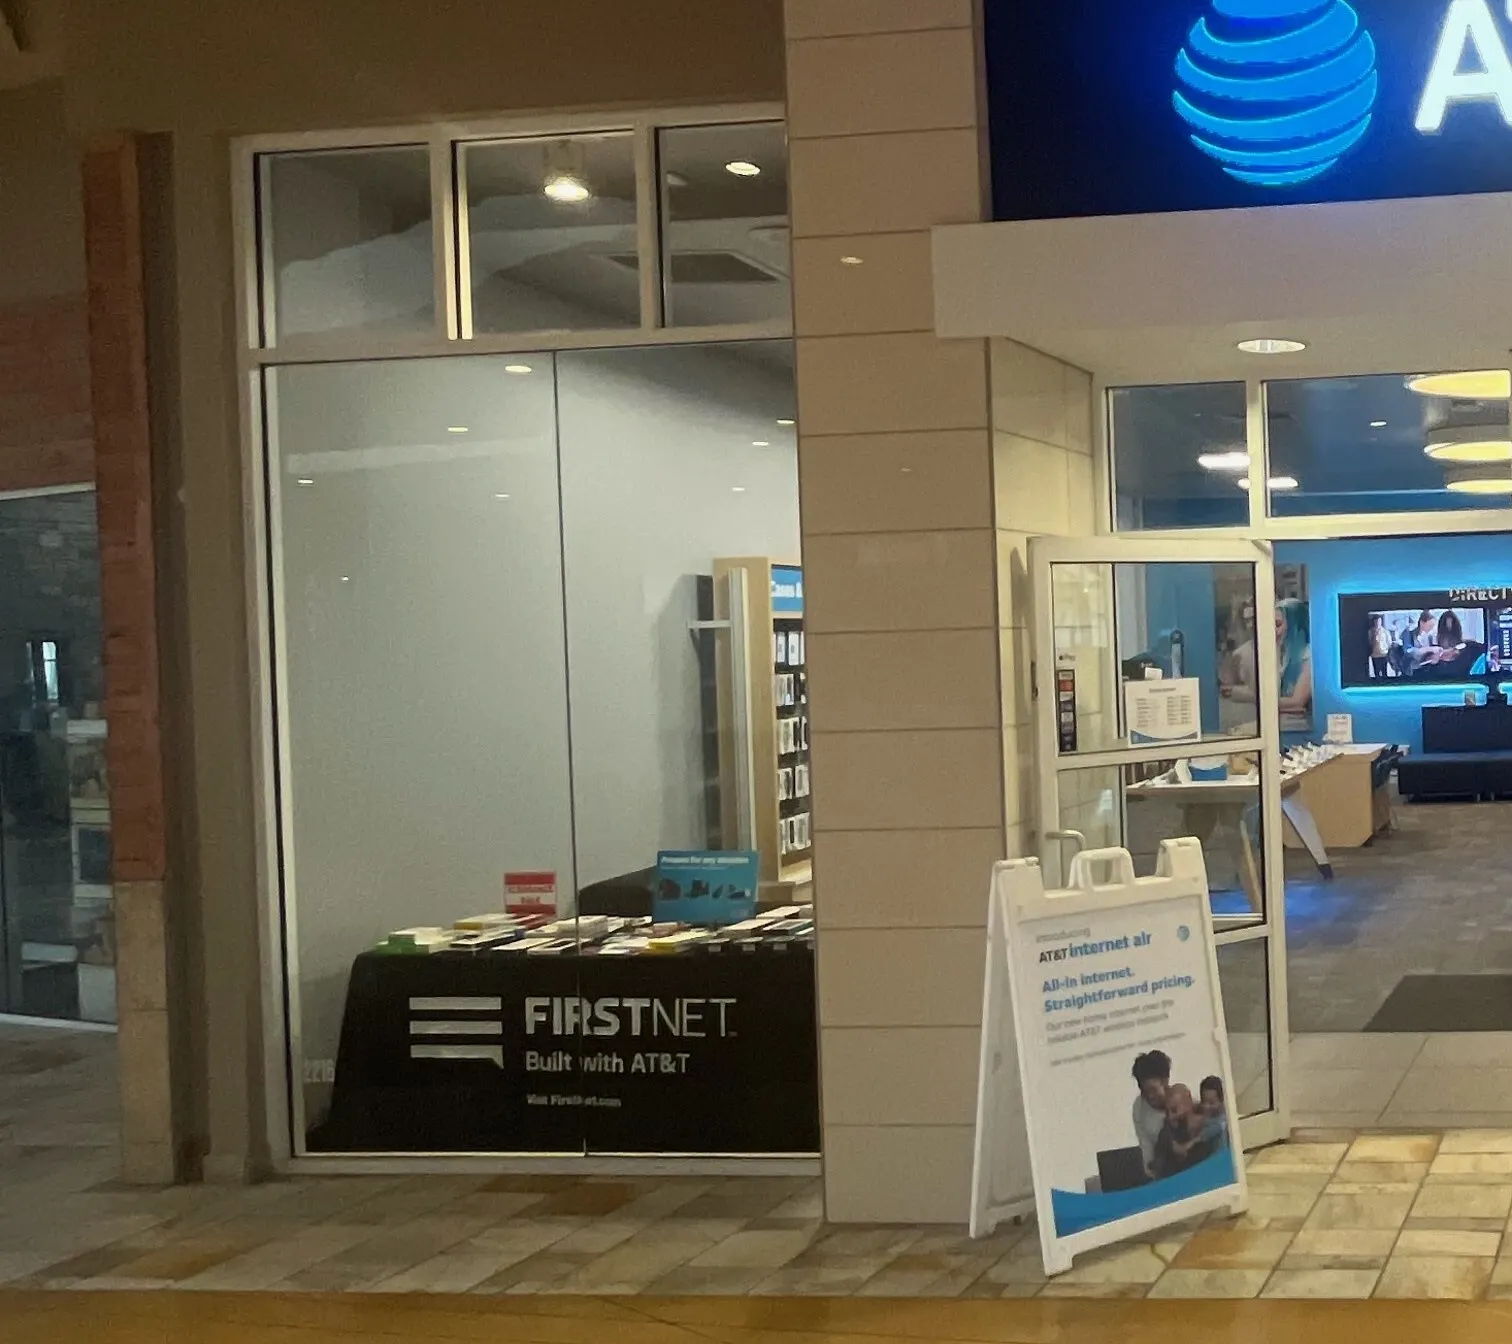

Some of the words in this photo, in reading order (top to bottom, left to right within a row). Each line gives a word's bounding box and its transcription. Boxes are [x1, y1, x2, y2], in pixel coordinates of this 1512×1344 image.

[1038, 947, 1068, 964] AT&T
[1068, 935, 1129, 958] internet
[1133, 931, 1152, 947] air
[1042, 977, 1078, 993] All-in
[1080, 966, 1135, 986] internet.
[1044, 980, 1148, 1013] Straightforward
[1151, 975, 1195, 995] pricing.
[525, 1050, 572, 1072] Built
[578, 1051, 624, 1073] with
[631, 1052, 690, 1073] AT&T
